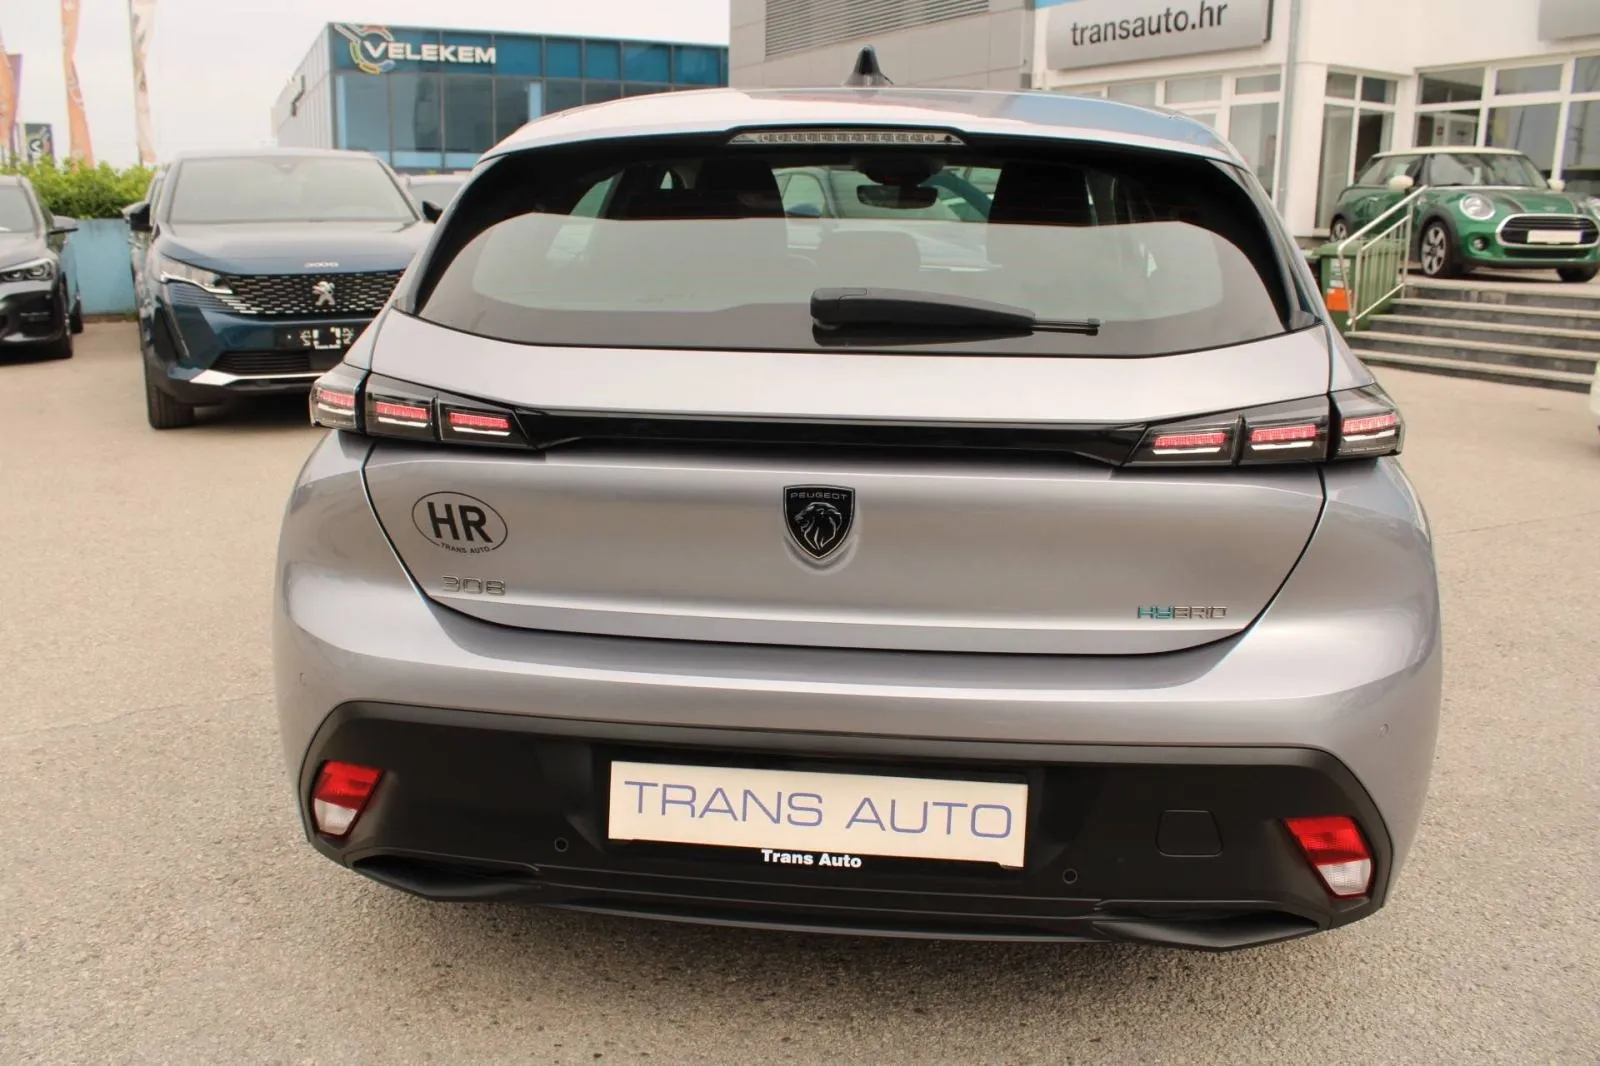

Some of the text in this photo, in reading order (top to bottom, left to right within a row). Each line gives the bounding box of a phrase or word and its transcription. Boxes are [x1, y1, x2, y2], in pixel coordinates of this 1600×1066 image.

[1070, 0, 1228, 47] transauto.hr
[363, 40, 497, 65] VELEKEM
[790, 491, 847, 500] PEUGEOT
[427, 501, 494, 543] HR
[440, 542, 490, 554] TRANS AUTO
[441, 575, 506, 596] 308
[1137, 604, 1228, 620] HYBRID
[624, 780, 1013, 839] TRANS AUTO
[761, 848, 862, 868] Trans Auto
